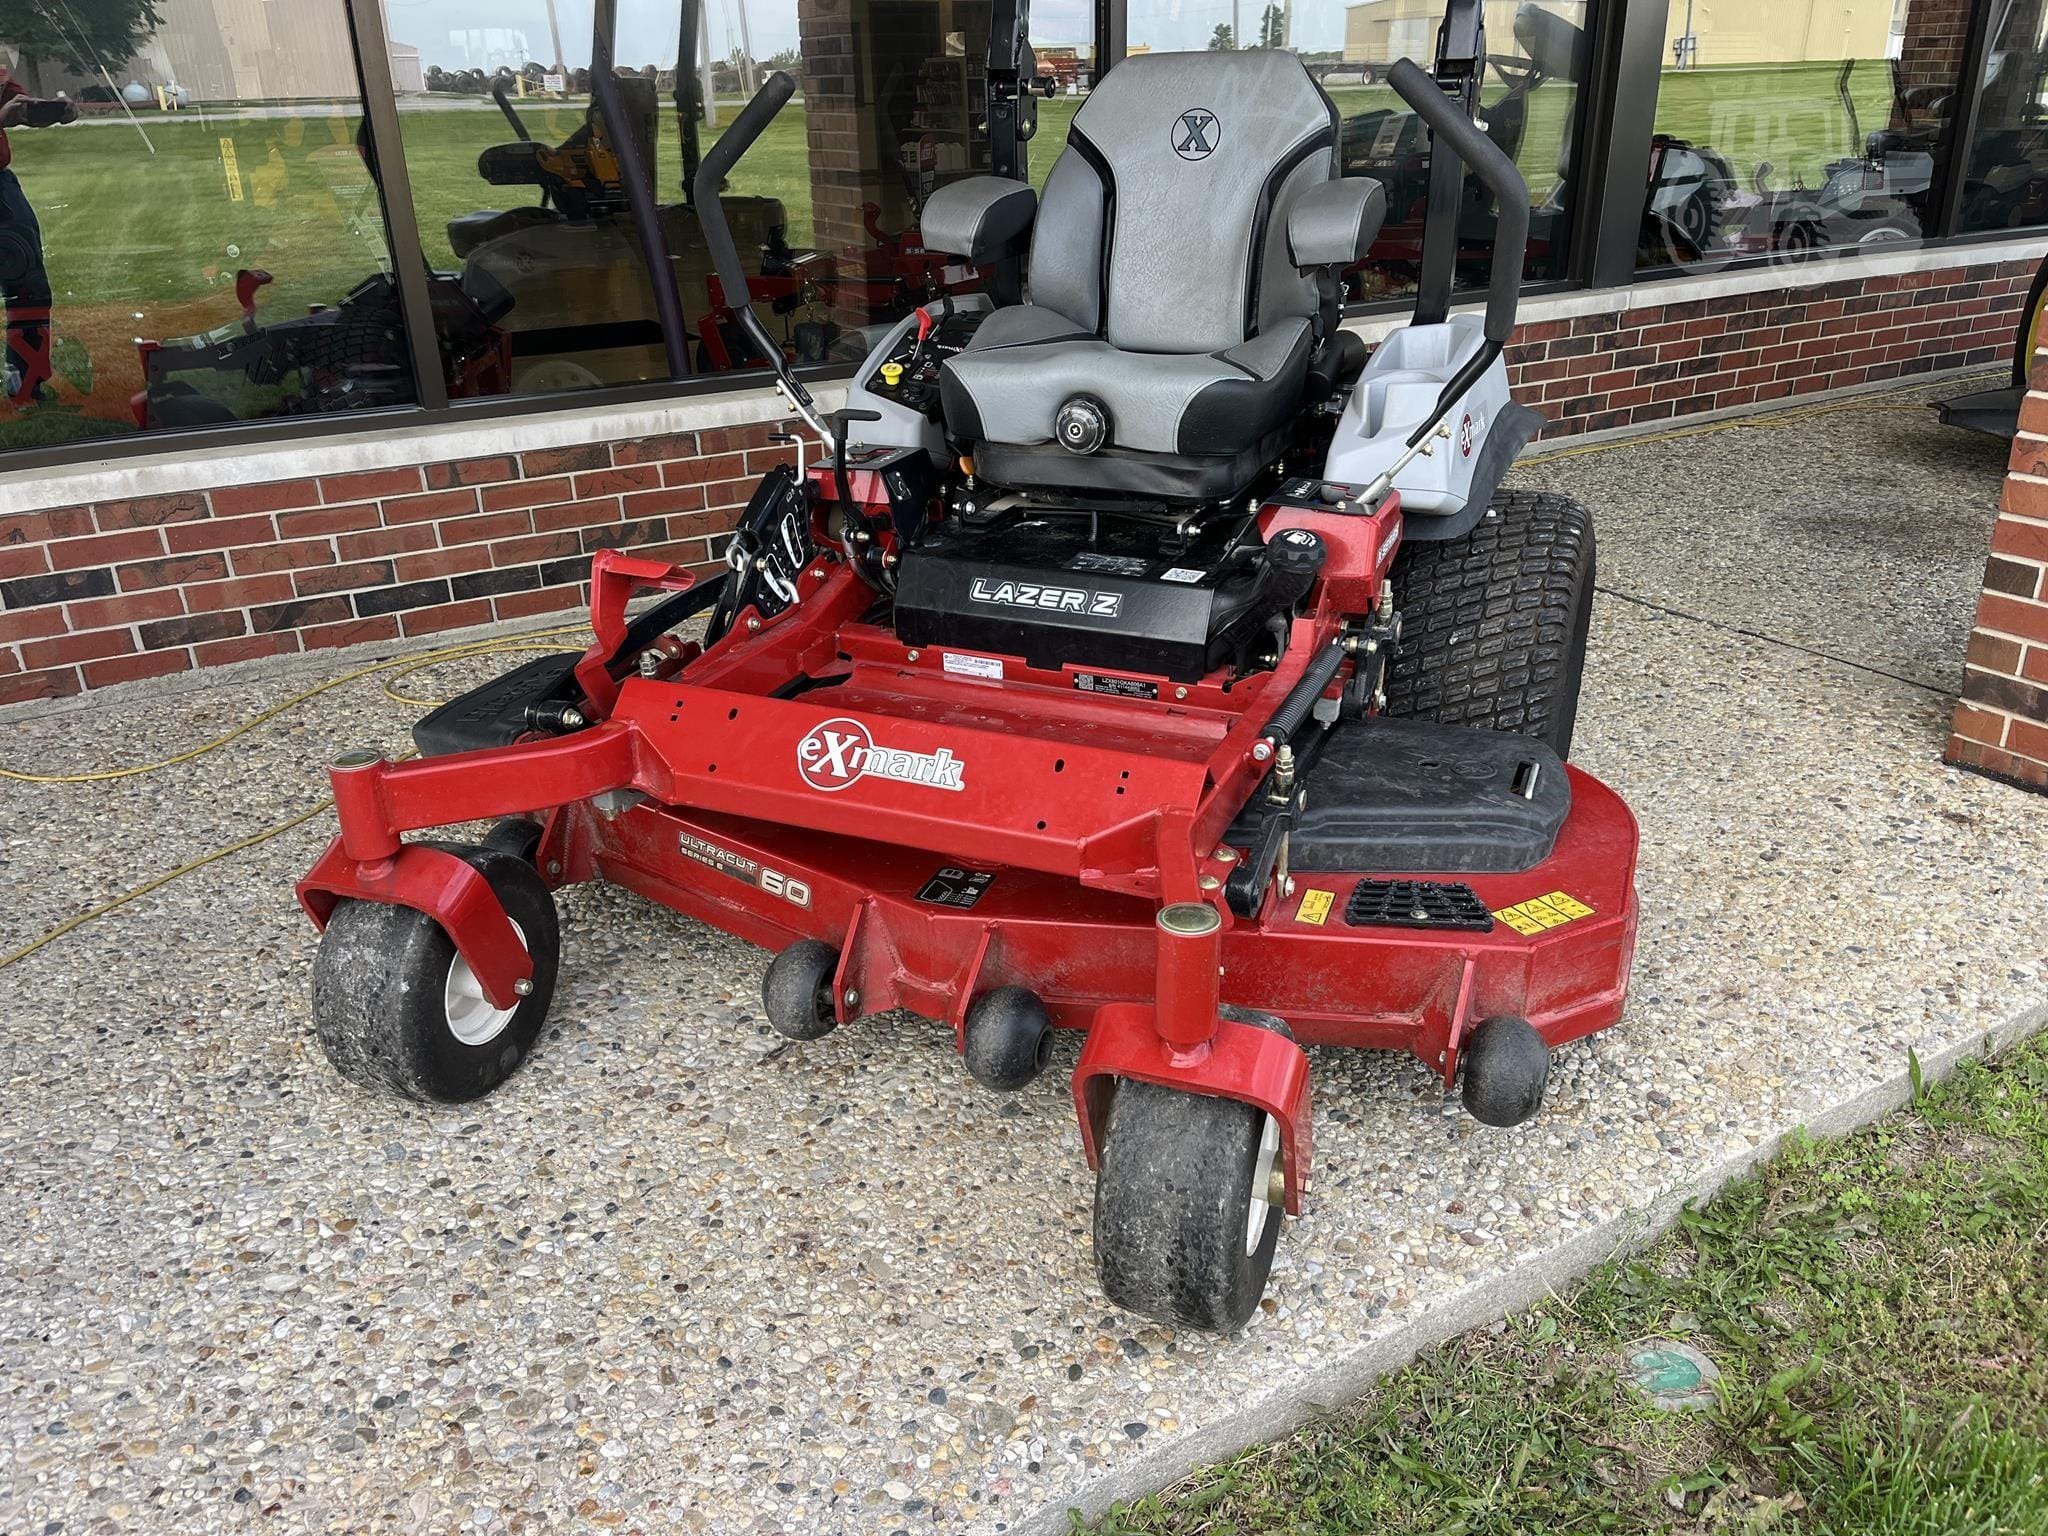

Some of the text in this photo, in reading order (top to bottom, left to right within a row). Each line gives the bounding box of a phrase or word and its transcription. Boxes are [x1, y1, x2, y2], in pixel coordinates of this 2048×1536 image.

[1177, 115, 1213, 152] X
[971, 579, 1121, 616] LAZER Z
[800, 730, 961, 787] eXmark
[680, 832, 757, 872] ULTRACUT
[681, 847, 714, 866] SERIES
[761, 868, 810, 906] 60
